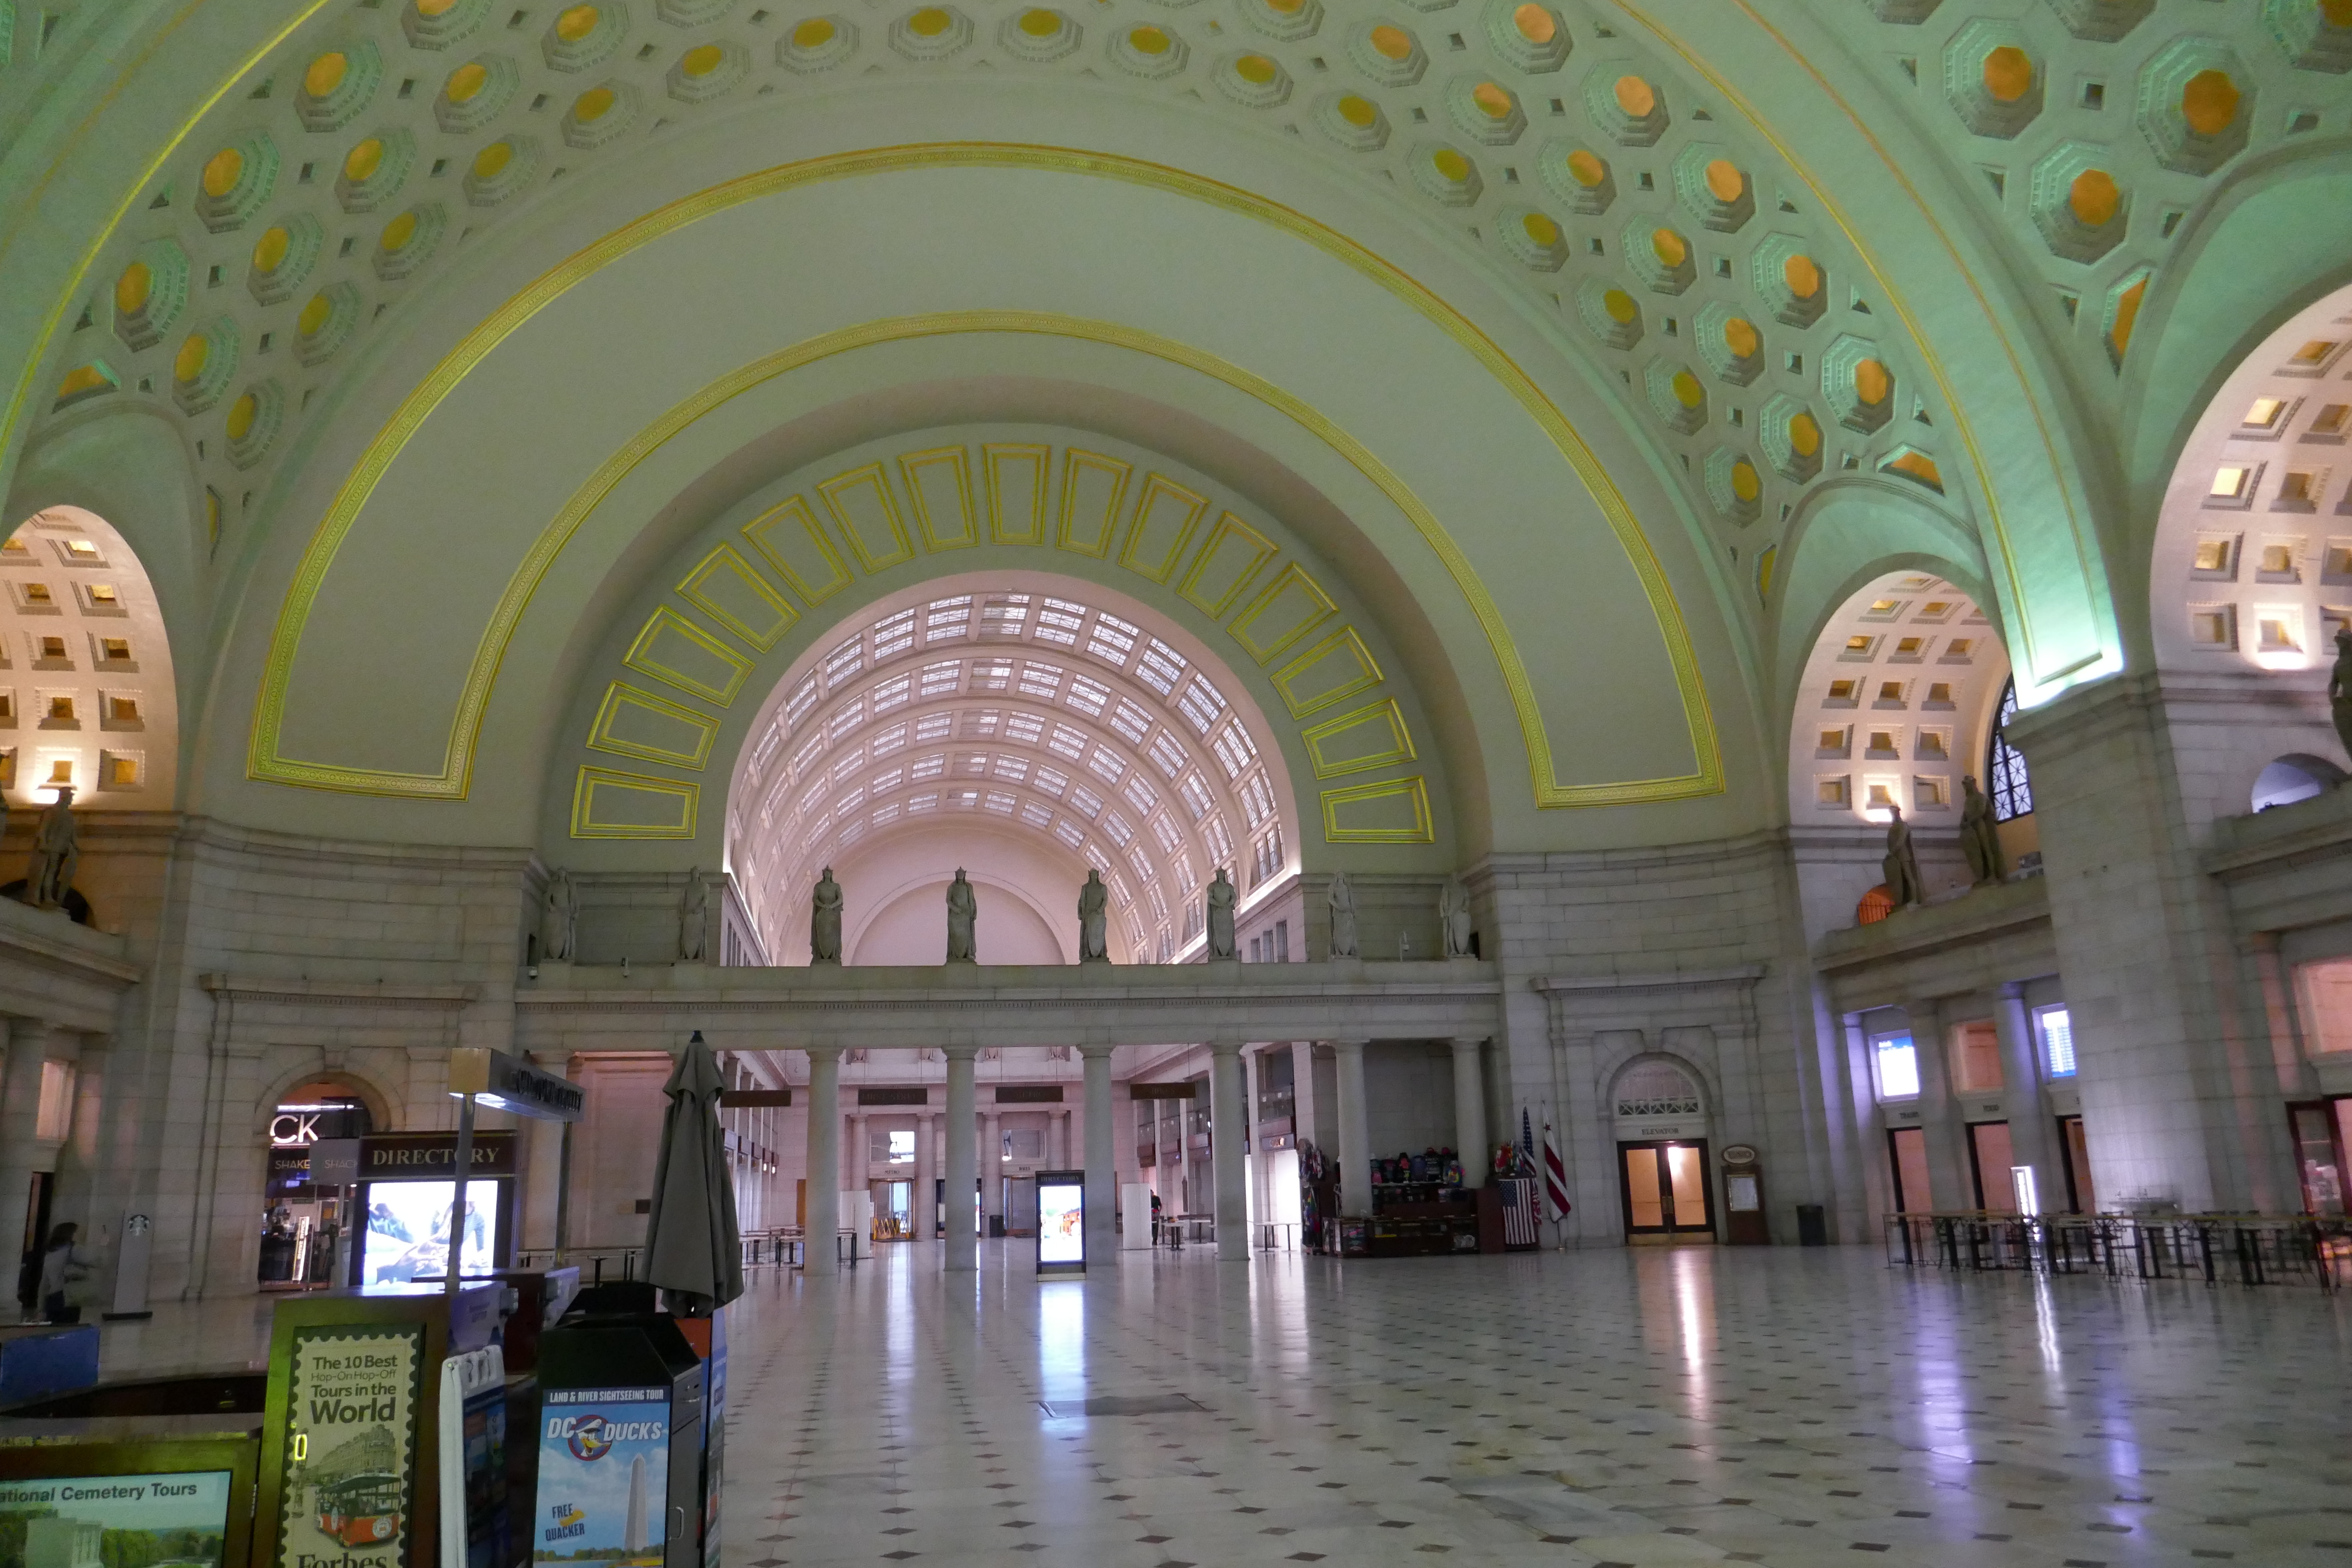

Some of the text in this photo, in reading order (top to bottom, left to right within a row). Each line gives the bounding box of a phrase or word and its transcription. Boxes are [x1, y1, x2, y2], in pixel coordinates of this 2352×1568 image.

[275, 1159, 311, 1169] SHAKE
[373, 1148, 499, 1165] DIRECTRY
[312, 1354, 398, 1369] The 10 Best
[311, 1369, 397, 1382] Hop-On Hop-Off
[311, 1382, 397, 1397] Tours in the
[549, 1389, 664, 1403] LAND & RIVER SIGHTSEEING TOUR
[310, 1397, 396, 1424] World
[547, 1417, 663, 1441] DC DUCKS
[61, 1485, 145, 1501] Cemetery
[151, 1482, 197, 1497] Tours
[552, 1504, 573, 1519] FREE
[545, 1523, 585, 1541] QUACKER
[297, 1552, 387, 1568] Forbes
